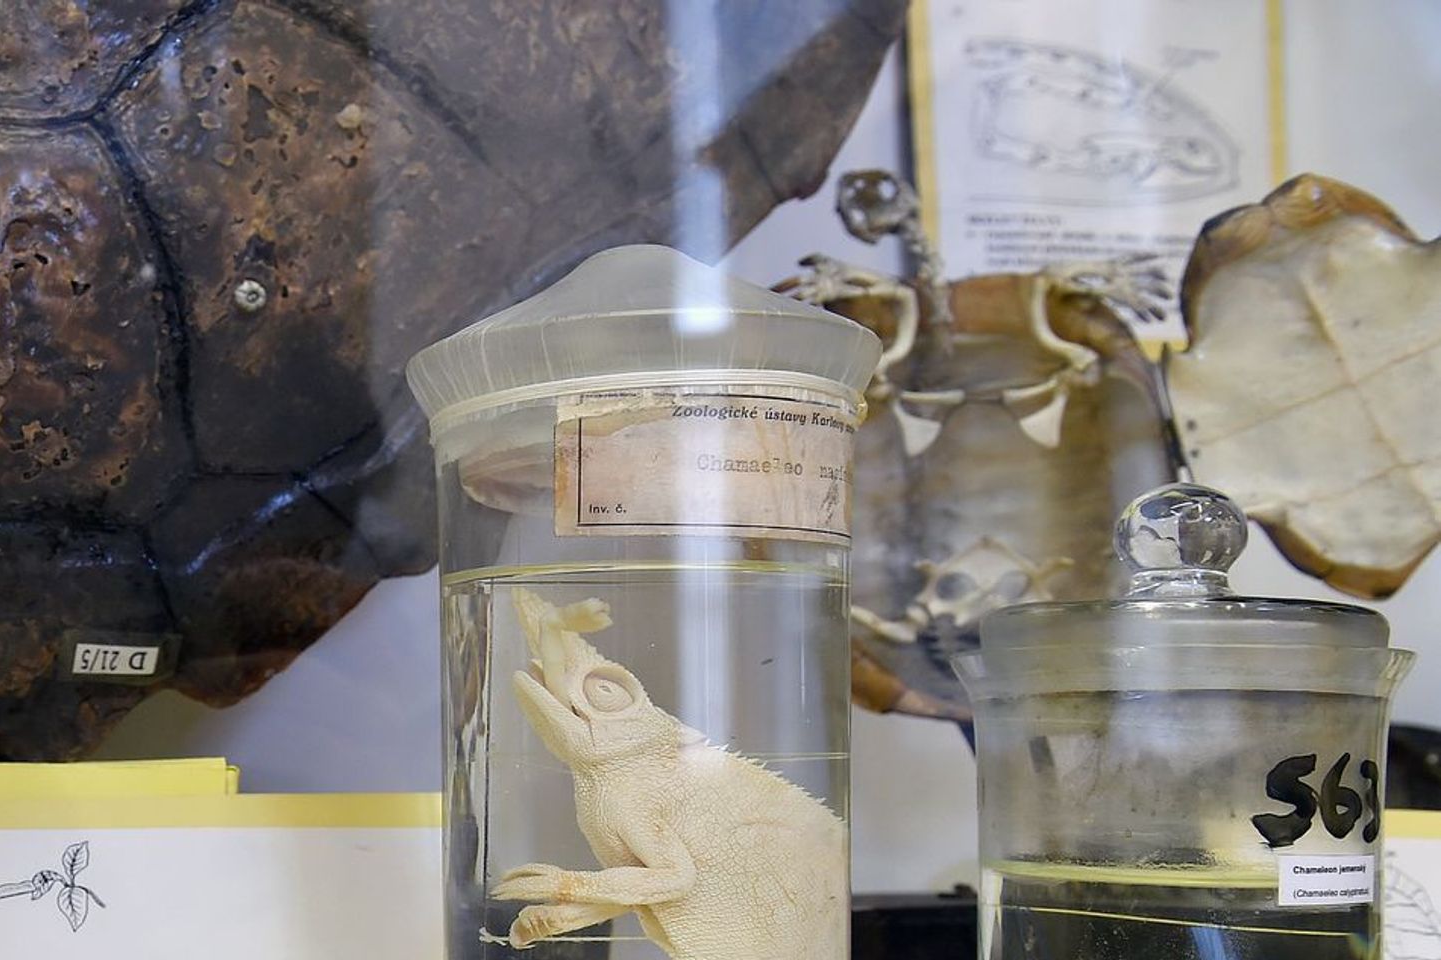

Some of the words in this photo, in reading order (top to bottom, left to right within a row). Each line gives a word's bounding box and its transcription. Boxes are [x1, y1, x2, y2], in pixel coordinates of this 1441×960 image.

[672, 405, 758, 421] Zoologické
[764, 407, 807, 426] ústavy
[588, 503, 609, 515] Inv.
[615, 503, 627, 515] č.
[129, 651, 147, 670] D
